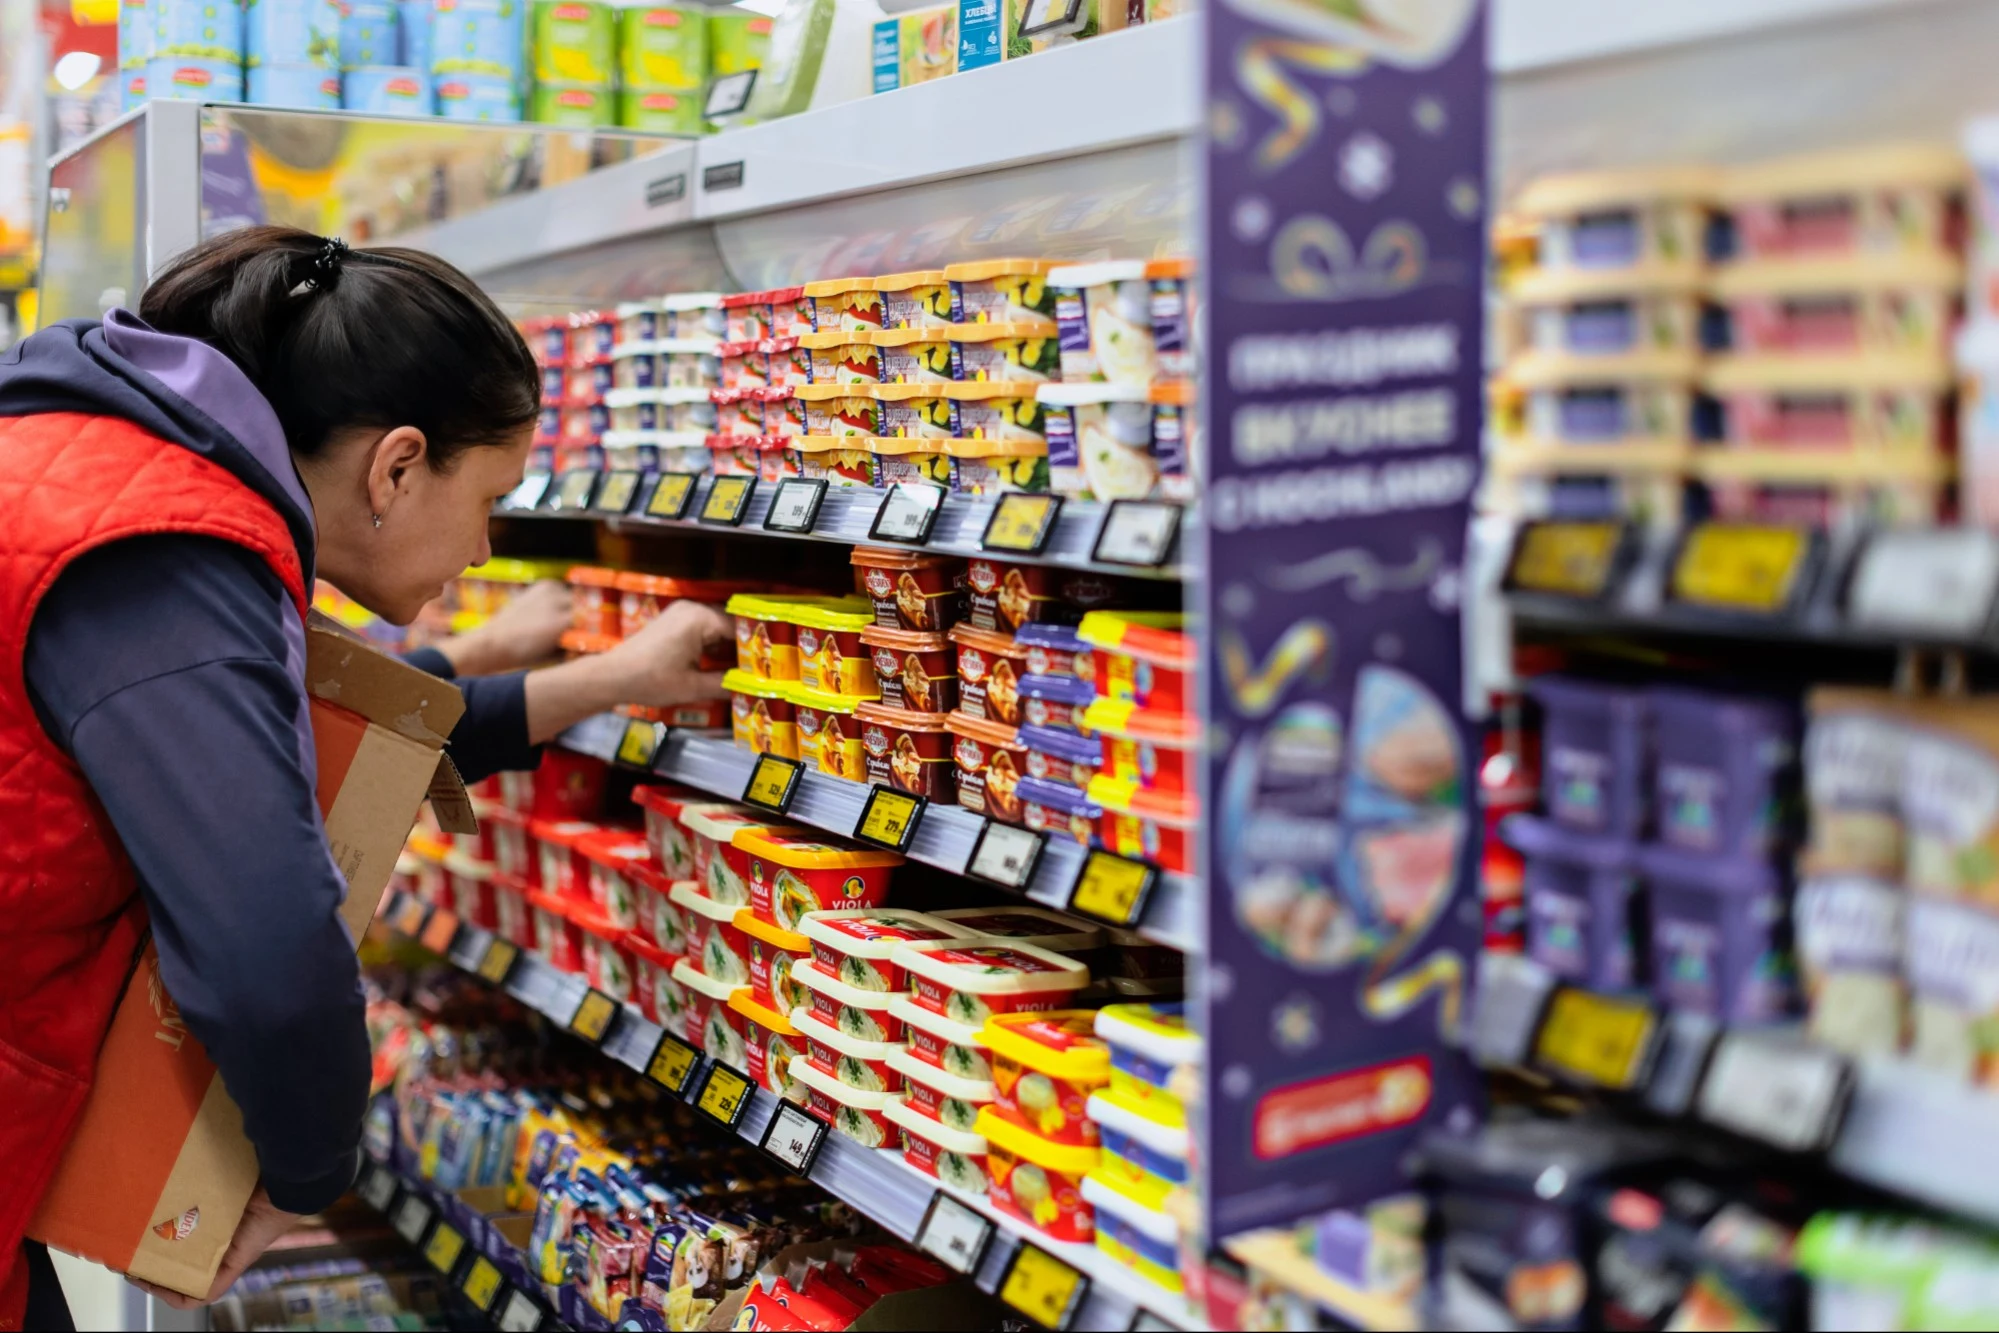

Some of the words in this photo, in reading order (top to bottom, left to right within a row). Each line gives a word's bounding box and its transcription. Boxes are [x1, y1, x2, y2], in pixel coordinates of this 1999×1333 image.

[750, 881, 769, 899] VIOLA
[832, 900, 873, 910] VIOLA
[816, 947, 835, 965] VIOLA
[750, 961, 767, 979] VIOLA
[918, 981, 941, 1000] VIOLA
[814, 996, 833, 1014] VIOLA
[745, 1040, 763, 1059] VIOLA
[915, 1032, 937, 1052] VIOLA
[813, 1045, 832, 1063] VIOLA
[812, 1094, 831, 1112] VIOLA
[913, 1084, 934, 1104] VIOLA
[789, 1138, 804, 1154] 149
[910, 1138, 932, 1156] VIOLA
